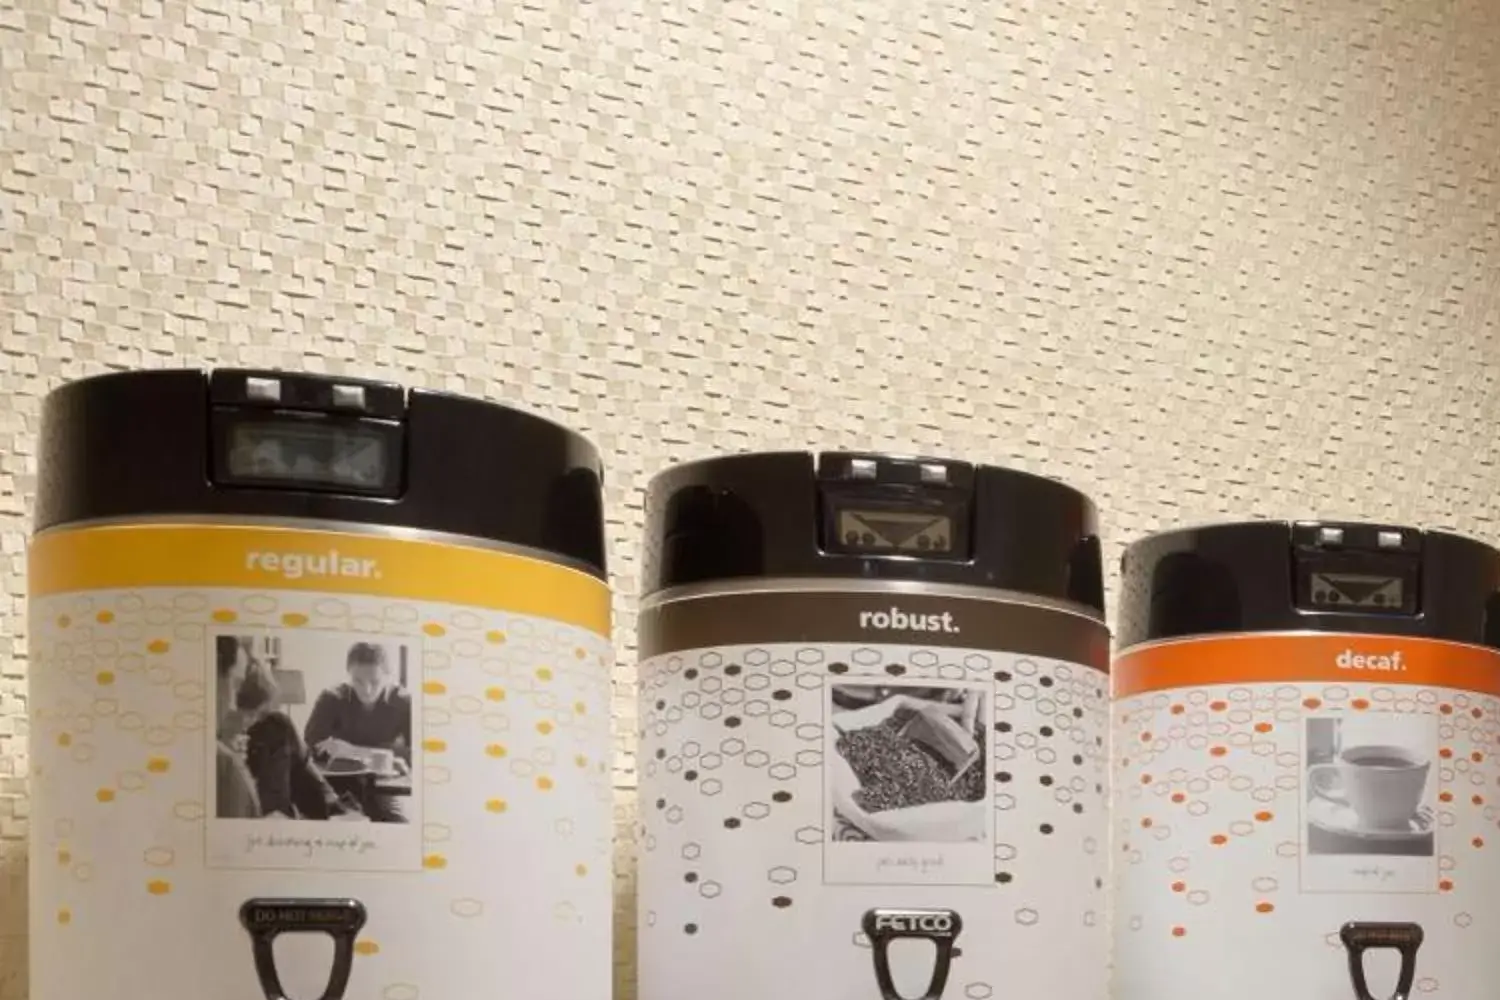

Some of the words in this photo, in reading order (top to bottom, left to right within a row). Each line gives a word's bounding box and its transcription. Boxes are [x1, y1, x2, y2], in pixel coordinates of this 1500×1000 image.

[246, 549, 383, 579] regular.
[860, 606, 960, 633] robust.
[1335, 649, 1407, 672] decaf.
[875, 914, 952, 931] FETCO
